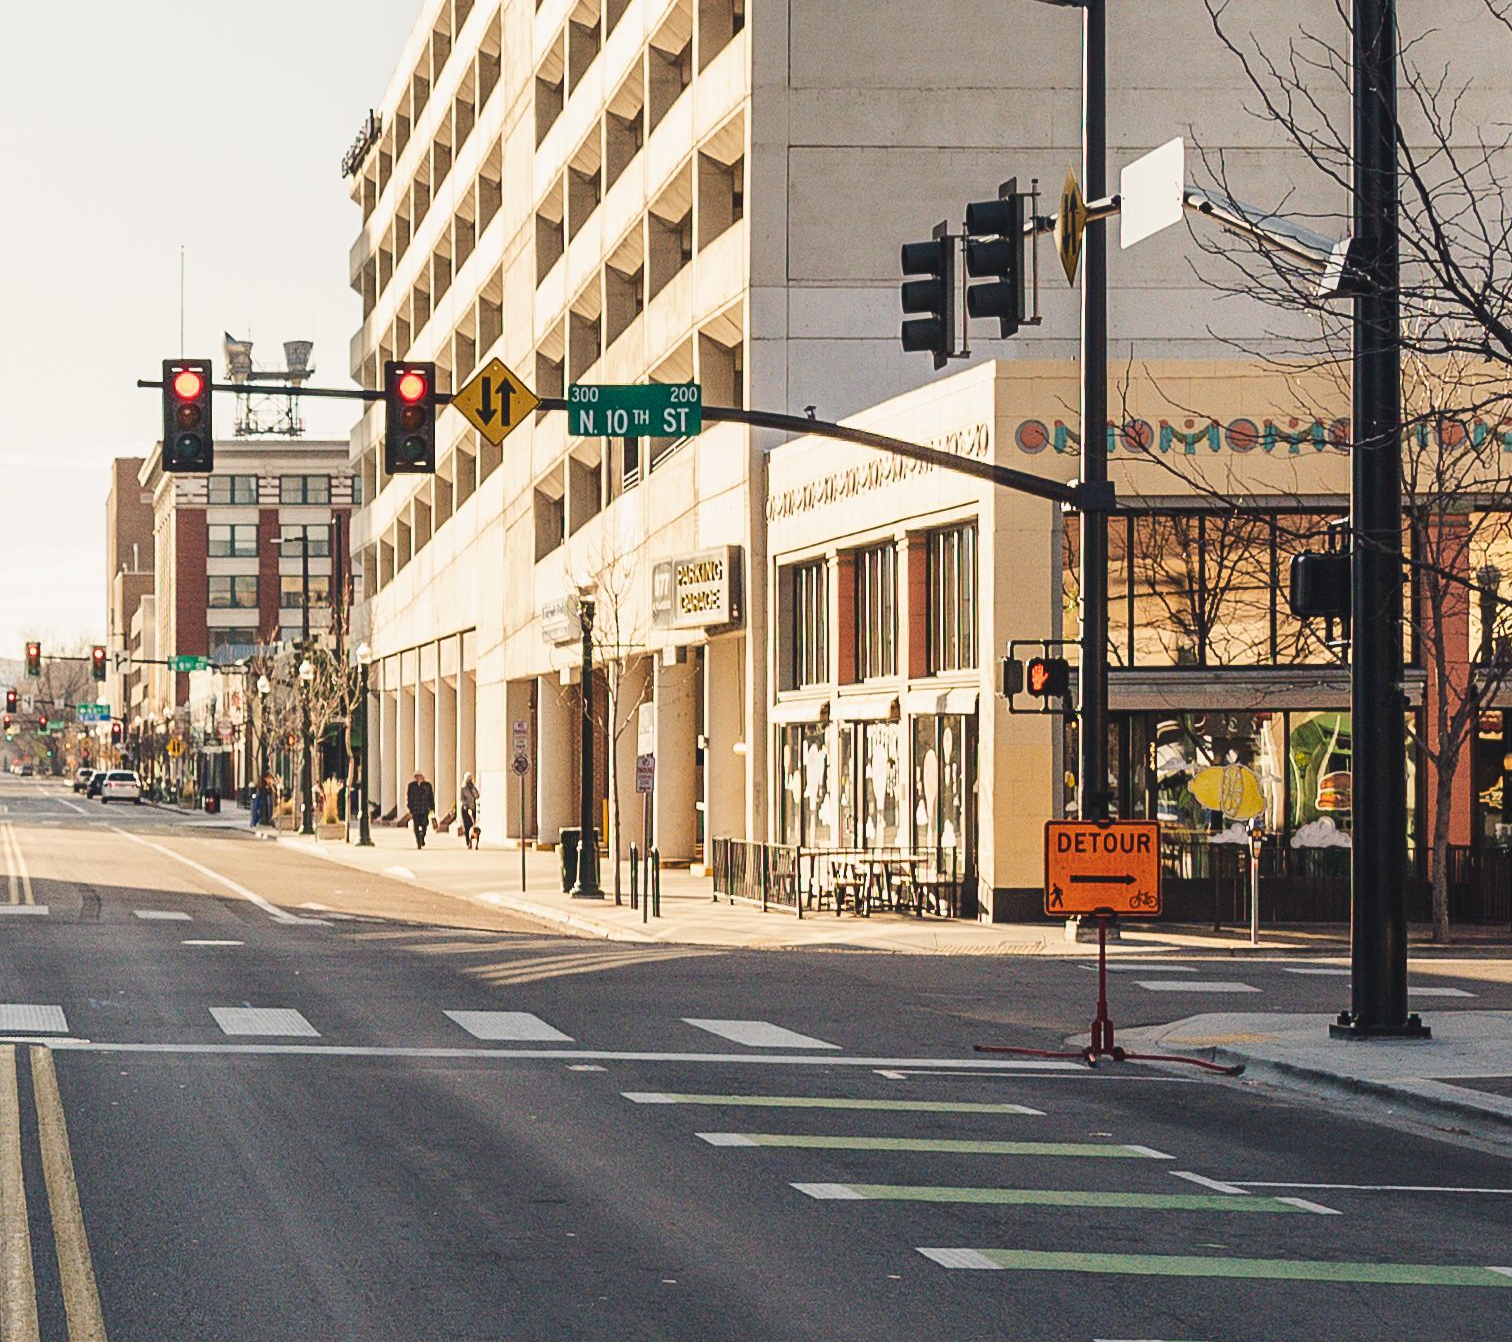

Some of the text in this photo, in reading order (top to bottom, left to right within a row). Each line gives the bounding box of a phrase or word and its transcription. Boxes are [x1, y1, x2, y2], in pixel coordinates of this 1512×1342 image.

[571, 386, 698, 402] 300 200
[579, 408, 689, 434] N. 10TH ST
[677, 560, 723, 586] PARKING
[1057, 832, 1151, 853] DETOUR
